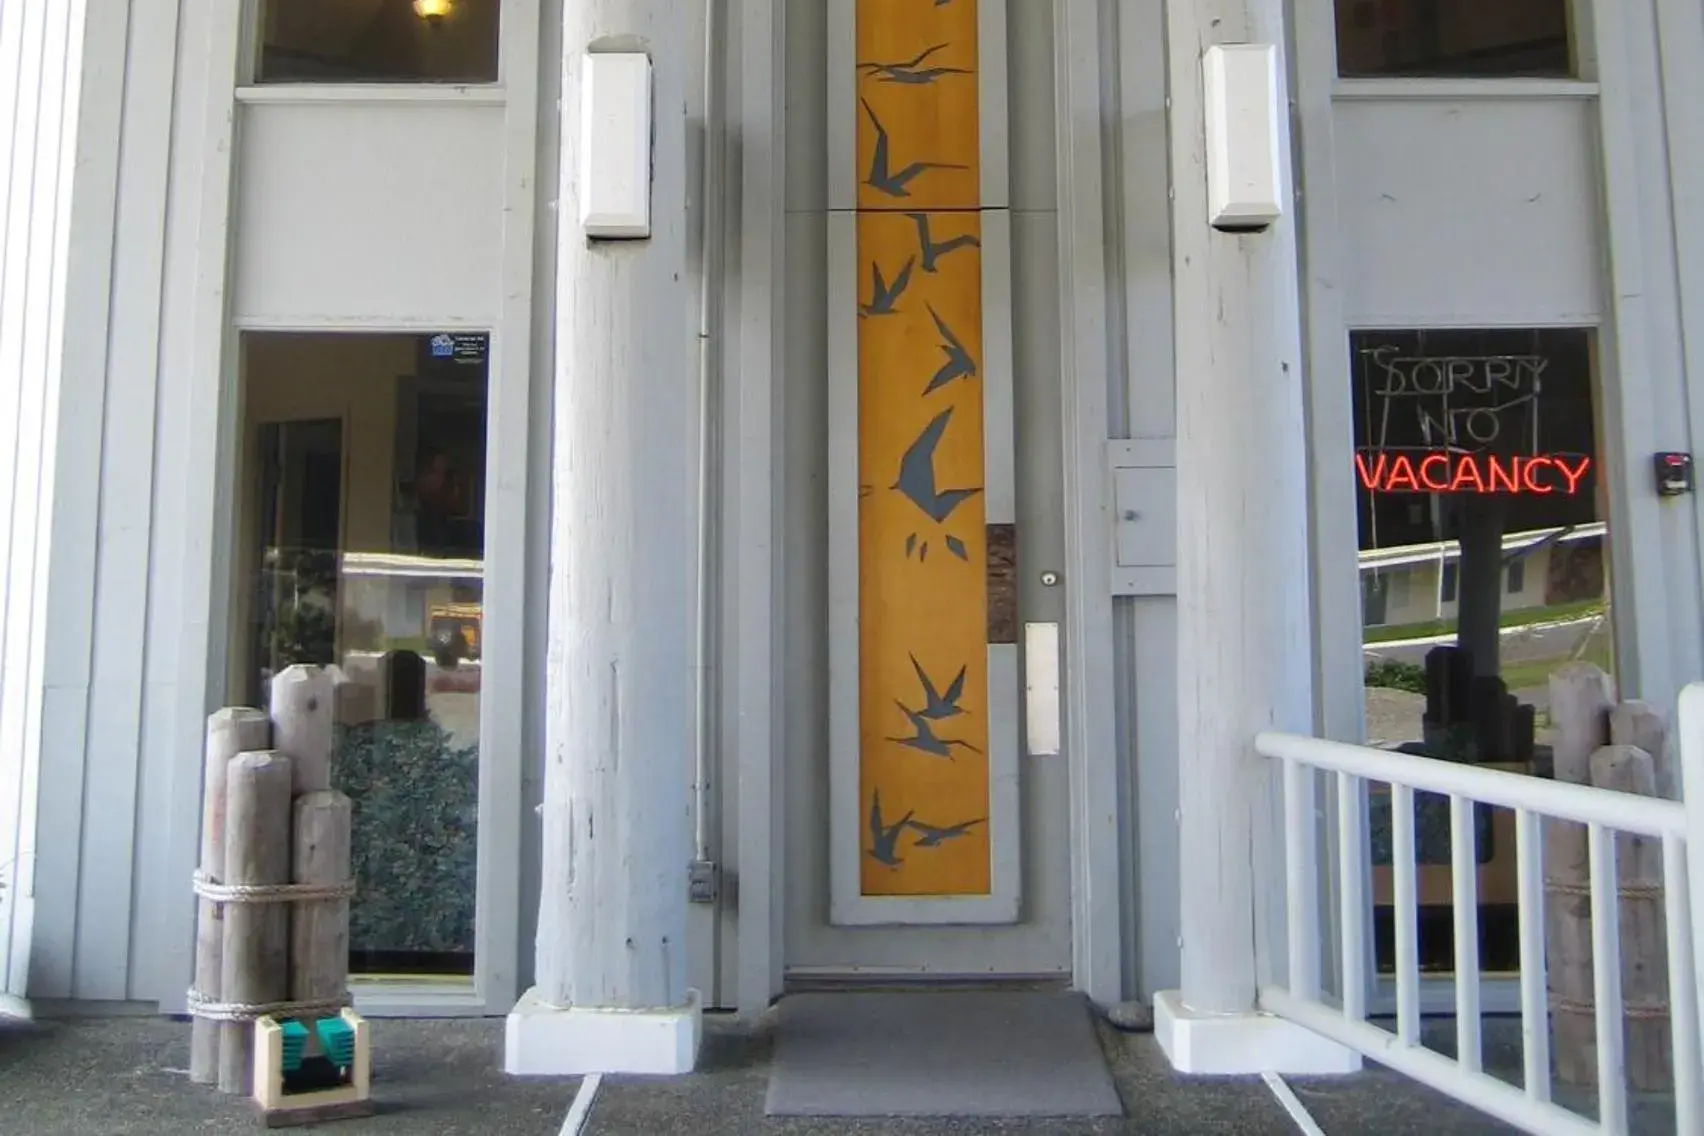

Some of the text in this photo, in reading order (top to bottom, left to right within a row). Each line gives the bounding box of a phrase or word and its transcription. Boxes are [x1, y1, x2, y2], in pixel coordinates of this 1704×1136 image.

[1373, 346, 1548, 395] SORRY
[1418, 405, 1500, 444] NO
[1355, 453, 1590, 494] VACANCY
